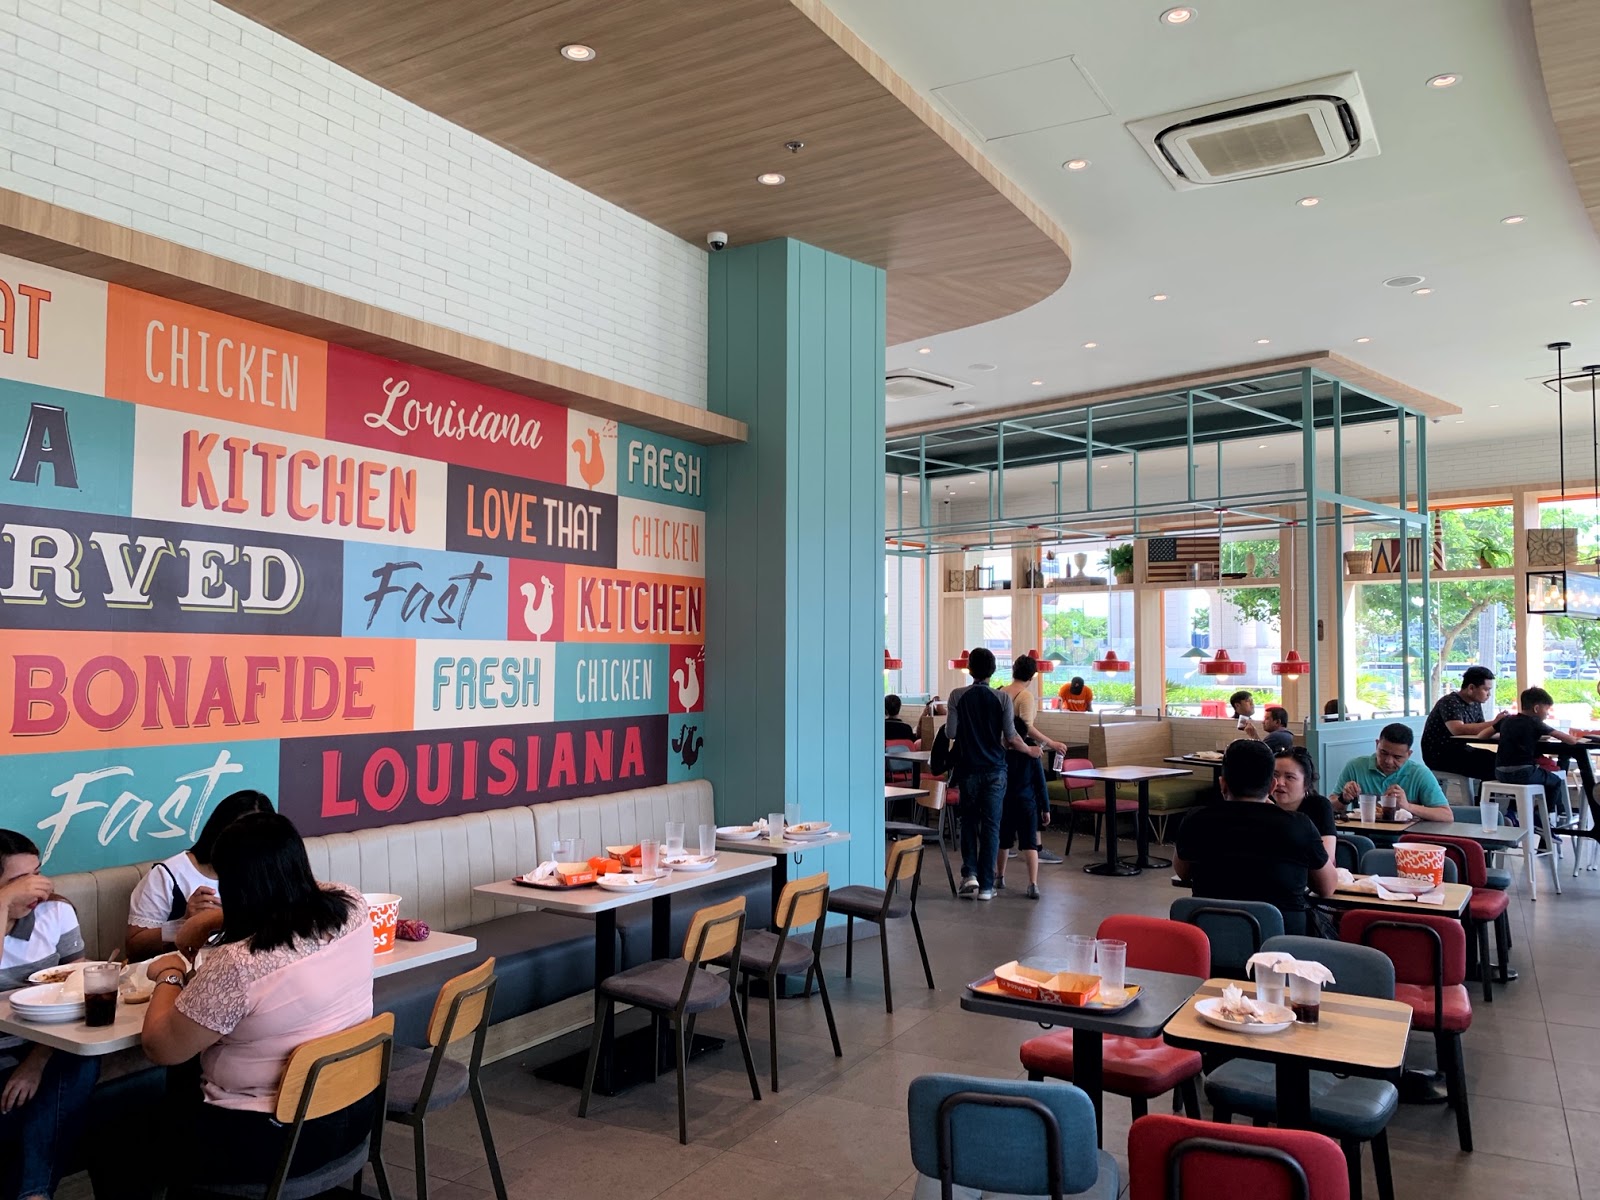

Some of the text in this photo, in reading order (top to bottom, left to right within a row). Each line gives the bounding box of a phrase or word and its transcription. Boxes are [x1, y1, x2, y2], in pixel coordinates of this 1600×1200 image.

[145, 319, 299, 412] CHICKEN
[9, 402, 81, 490] A
[363, 377, 543, 450] Louisiana
[181, 429, 417, 536] KITCHEN
[627, 440, 702, 498] FRESH
[466, 484, 602, 552] LOVE THAT
[631, 514, 700, 563] CHICKEN
[0, 523, 306, 616] RVED
[364, 560, 493, 631] Fast
[576, 576, 702, 636] KITCHEN
[9, 655, 376, 737] BONAFIDE
[432, 656, 541, 712] FRESH
[576, 658, 653, 703] CHICKEN
[37, 749, 244, 866] Fast
[321, 726, 646, 819] LOUISIANA
